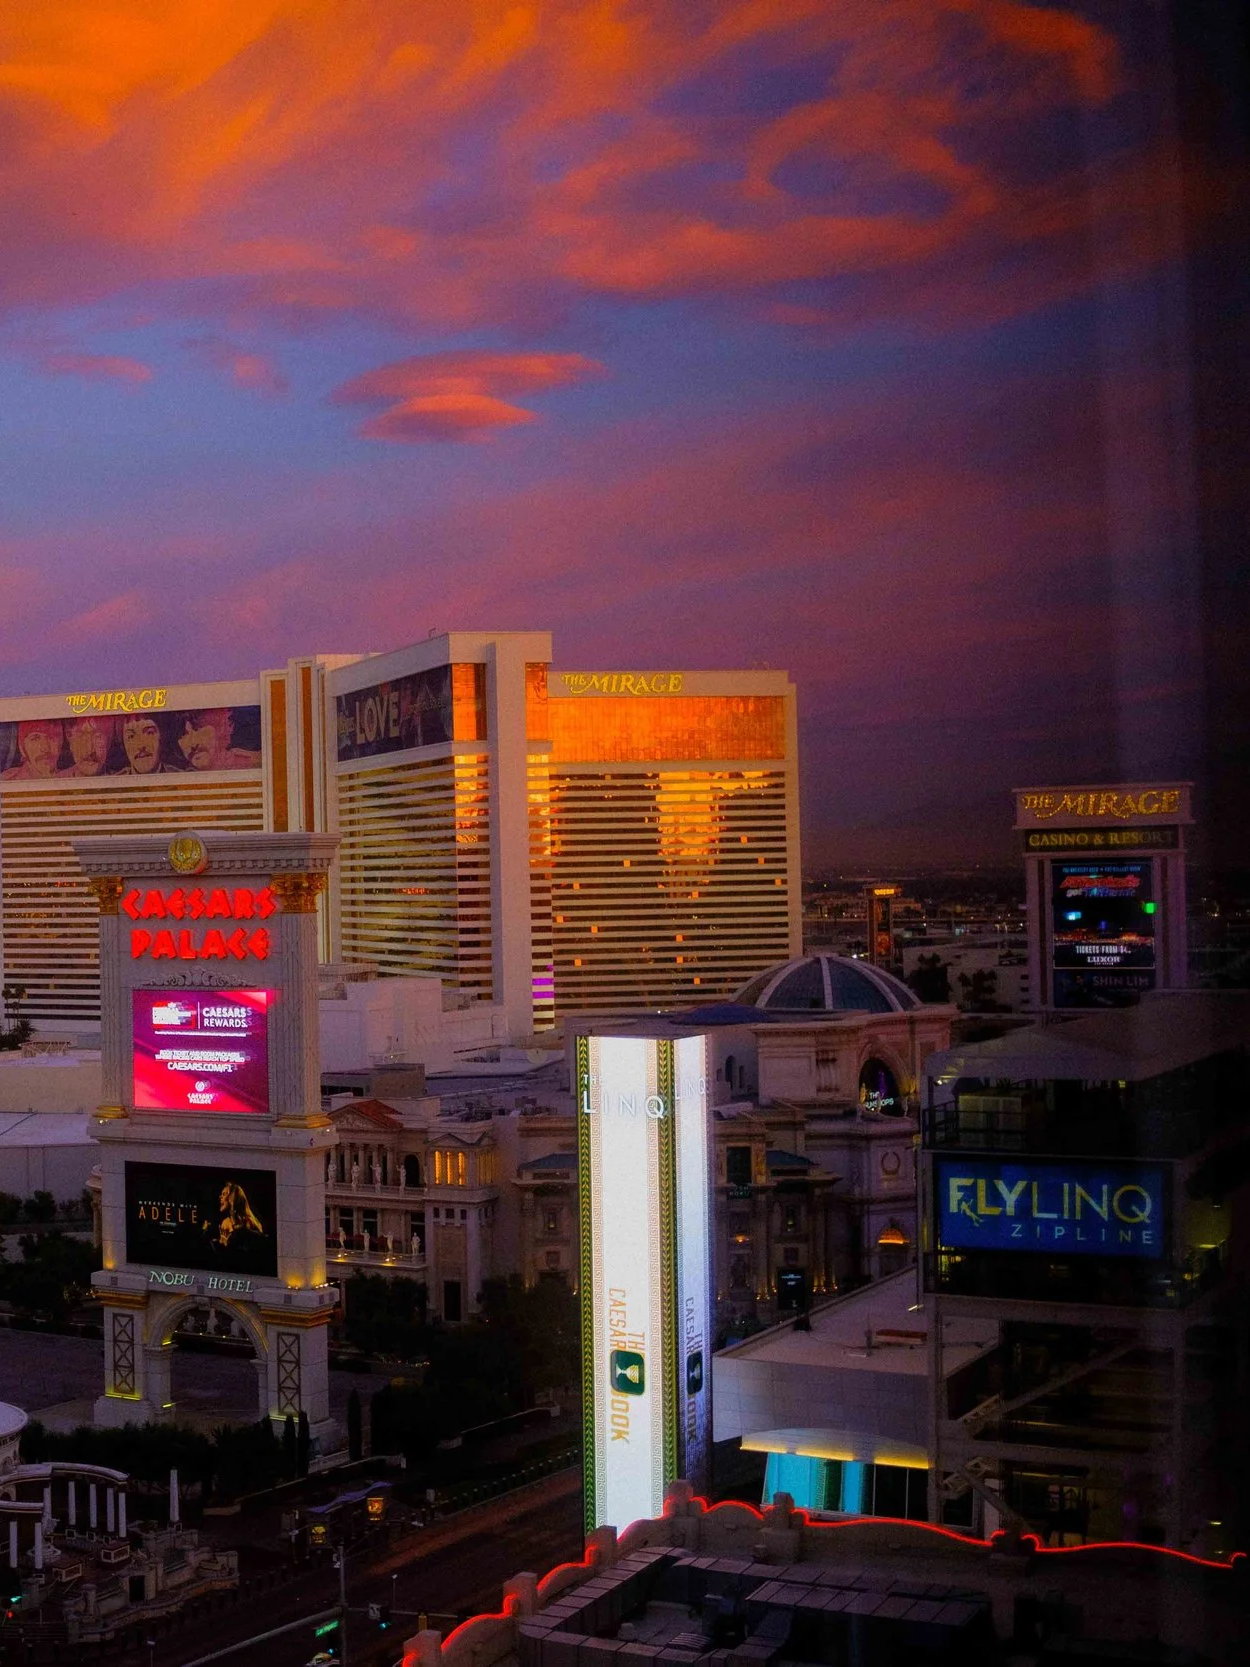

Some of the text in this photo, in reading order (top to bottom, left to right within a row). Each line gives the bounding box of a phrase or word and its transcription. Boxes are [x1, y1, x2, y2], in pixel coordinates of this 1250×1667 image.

[562, 673, 683, 695] THE MIRAGE
[66, 688, 167, 714] THE MIRAGE
[355, 691, 400, 745] LOVE
[1021, 789, 1181, 819] THE MIRAGE
[1028, 830, 1173, 848] CASINO & RESORT
[121, 888, 277, 920] CAESARS
[131, 927, 270, 960] PALACE
[1092, 975, 1123, 987] SHIN
[202, 1007, 248, 1019] CAESARS
[584, 1090, 665, 1119] LINQ
[138, 1206, 198, 1224] ADELE
[1010, 1224, 1154, 1245] ZIPLINE
[150, 1270, 254, 1293] NOBU HOTEL
